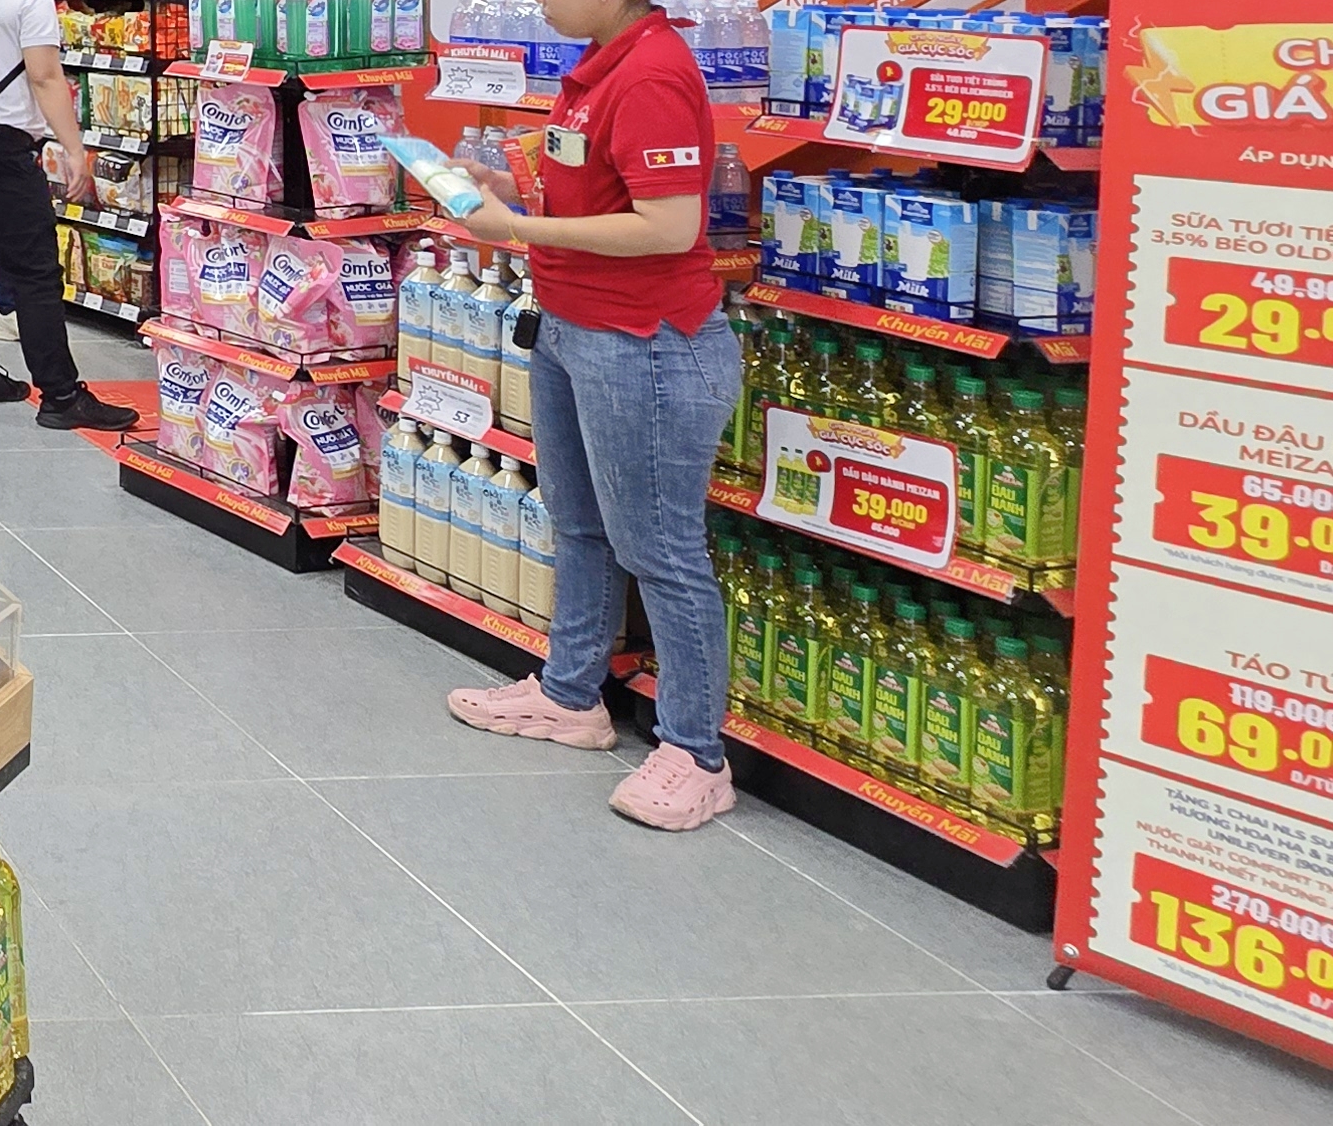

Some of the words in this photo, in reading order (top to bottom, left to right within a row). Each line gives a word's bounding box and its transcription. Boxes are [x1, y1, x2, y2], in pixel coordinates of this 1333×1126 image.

[450, 45, 489, 59] KHUYẾN
[490, 49, 510, 60] MÃI
[357, 72, 396, 85] Khuyến
[925, 97, 1007, 126] 29.000
[1201, 74, 1328, 121] GIÁ
[1238, 146, 1274, 163] ÁP
[1170, 211, 1224, 232] SỮA
[1228, 218, 1293, 239] TƯƠI
[1151, 229, 1208, 248] 3,5%
[1215, 234, 1268, 255] BÉO
[1275, 244, 1333, 262] OLD
[771, 256, 801, 273] Milk
[831, 266, 860, 284] Milk
[747, 285, 780, 304] Mãi
[895, 280, 929, 297] Milk
[876, 313, 950, 343] Khuyến
[953, 330, 995, 351] Mãi
[311, 367, 349, 382] Khuyến
[350, 366, 370, 378] Mãi
[421, 365, 459, 387] KHUYẾN
[452, 411, 470, 424] 53
[1178, 410, 1245, 437] DẦU
[1239, 445, 1333, 475] MEIZA
[852, 488, 928, 524] 39.000
[971, 570, 1012, 595] Mãi
[482, 614, 531, 645] Khuyến
[1225, 650, 1291, 681] TÁO
[1177, 697, 1333, 772] 69.0
[857, 780, 935, 824] Khuyến
[937, 813, 981, 845] Mãi
[1165, 786, 1210, 809] TẶNG
[1214, 803, 1223, 814] 1
[1227, 807, 1269, 829] CHAI
[1273, 821, 1307, 841] NLS
[1170, 802, 1231, 831] HƯƠNG
[1234, 822, 1274, 844] HOA
[1136, 819, 1183, 845] NƯỚC
[1186, 834, 1224, 857] GIẶT
[1227, 850, 1313, 886] COMFORT
[1207, 828, 1291, 865] UNILEVER
[1146, 836, 1204, 865] THANH
[1208, 853, 1257, 883] KHIẾT
[1261, 873, 1327, 908] HƯƠNG
[1150, 890, 1333, 990] 136.0
